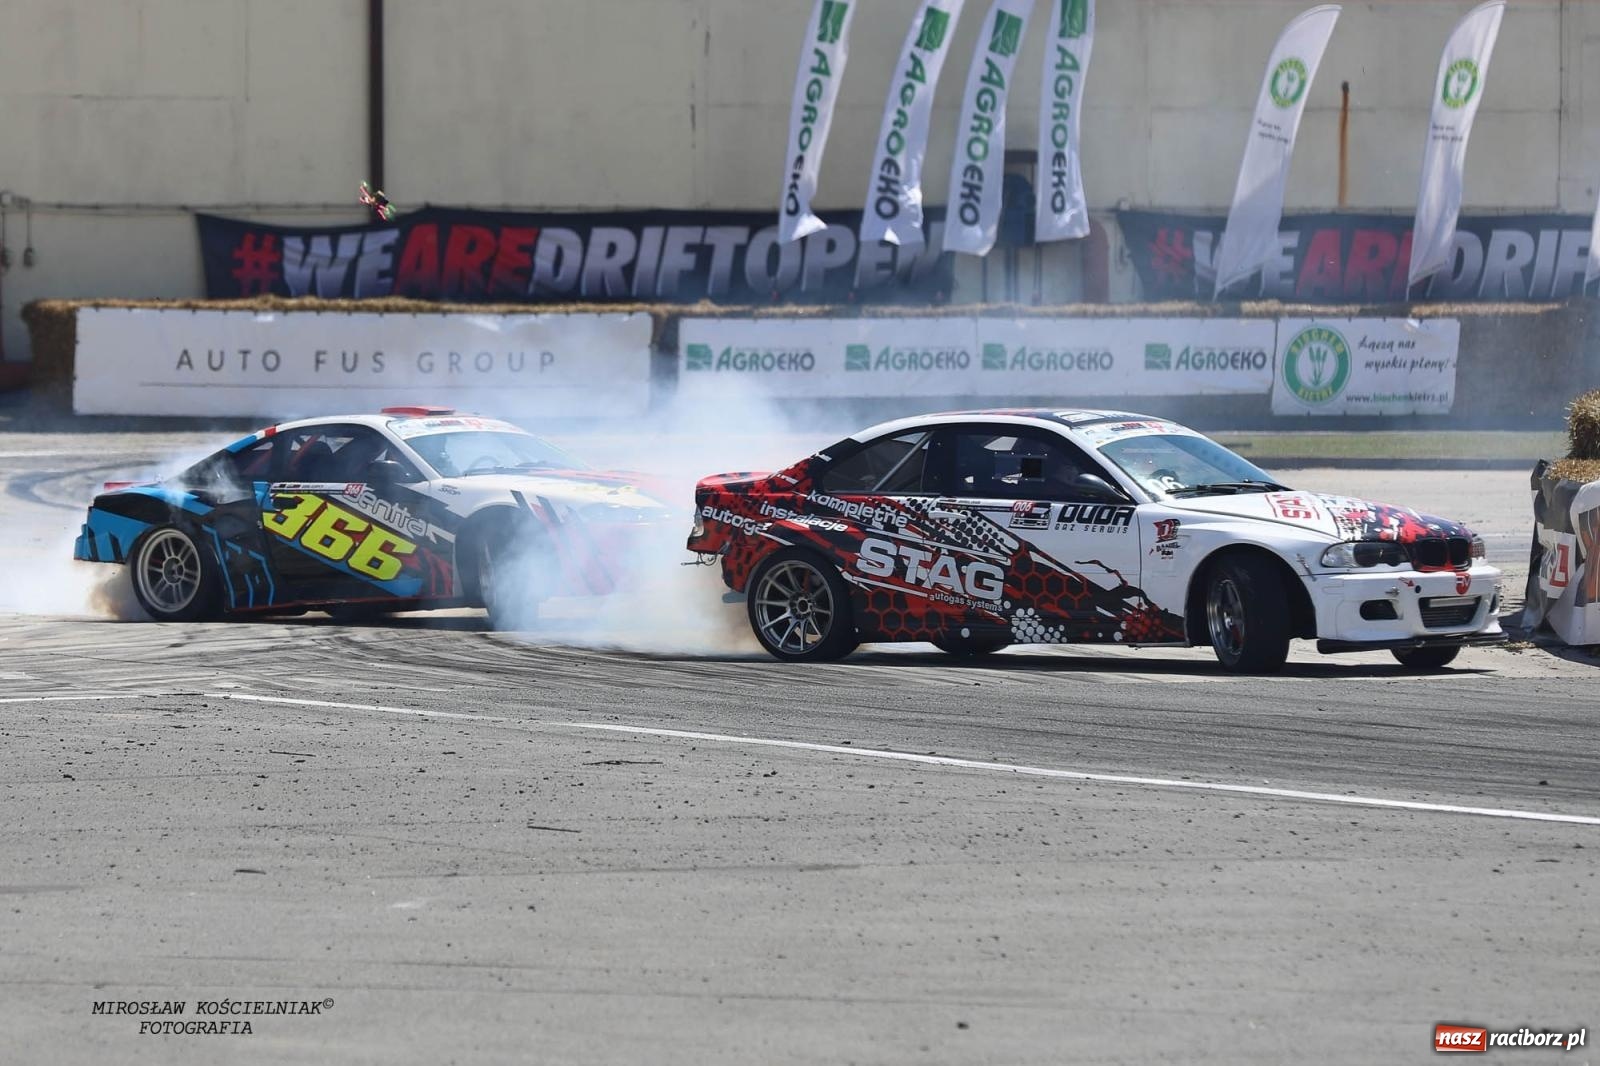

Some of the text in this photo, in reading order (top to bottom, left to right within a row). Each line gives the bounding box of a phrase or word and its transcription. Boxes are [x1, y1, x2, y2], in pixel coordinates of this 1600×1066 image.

[785, 47, 832, 218] AGROEKO
[874, 51, 927, 221] AGROEKO
[959, 57, 1006, 228] AGROEKO
[1050, 43, 1081, 215] AGROEKO
[175, 348, 556, 374] AUTO FUS GROUP
[714, 345, 816, 372] AGROEKO
[872, 345, 971, 372] AGROEKO
[1009, 345, 1114, 372] AGROEKO
[1174, 345, 1268, 372] AGROEKO
[759, 500, 849, 532] instalacje
[806, 489, 908, 528] kompletne
[1013, 500, 1033, 513] 006
[1056, 503, 1137, 527] DUDA
[262, 492, 417, 582] 366
[1054, 523, 1130, 534] GAZ SERWIS
[855, 537, 1006, 601] STAG
[929, 592, 1004, 612] autogas systems
